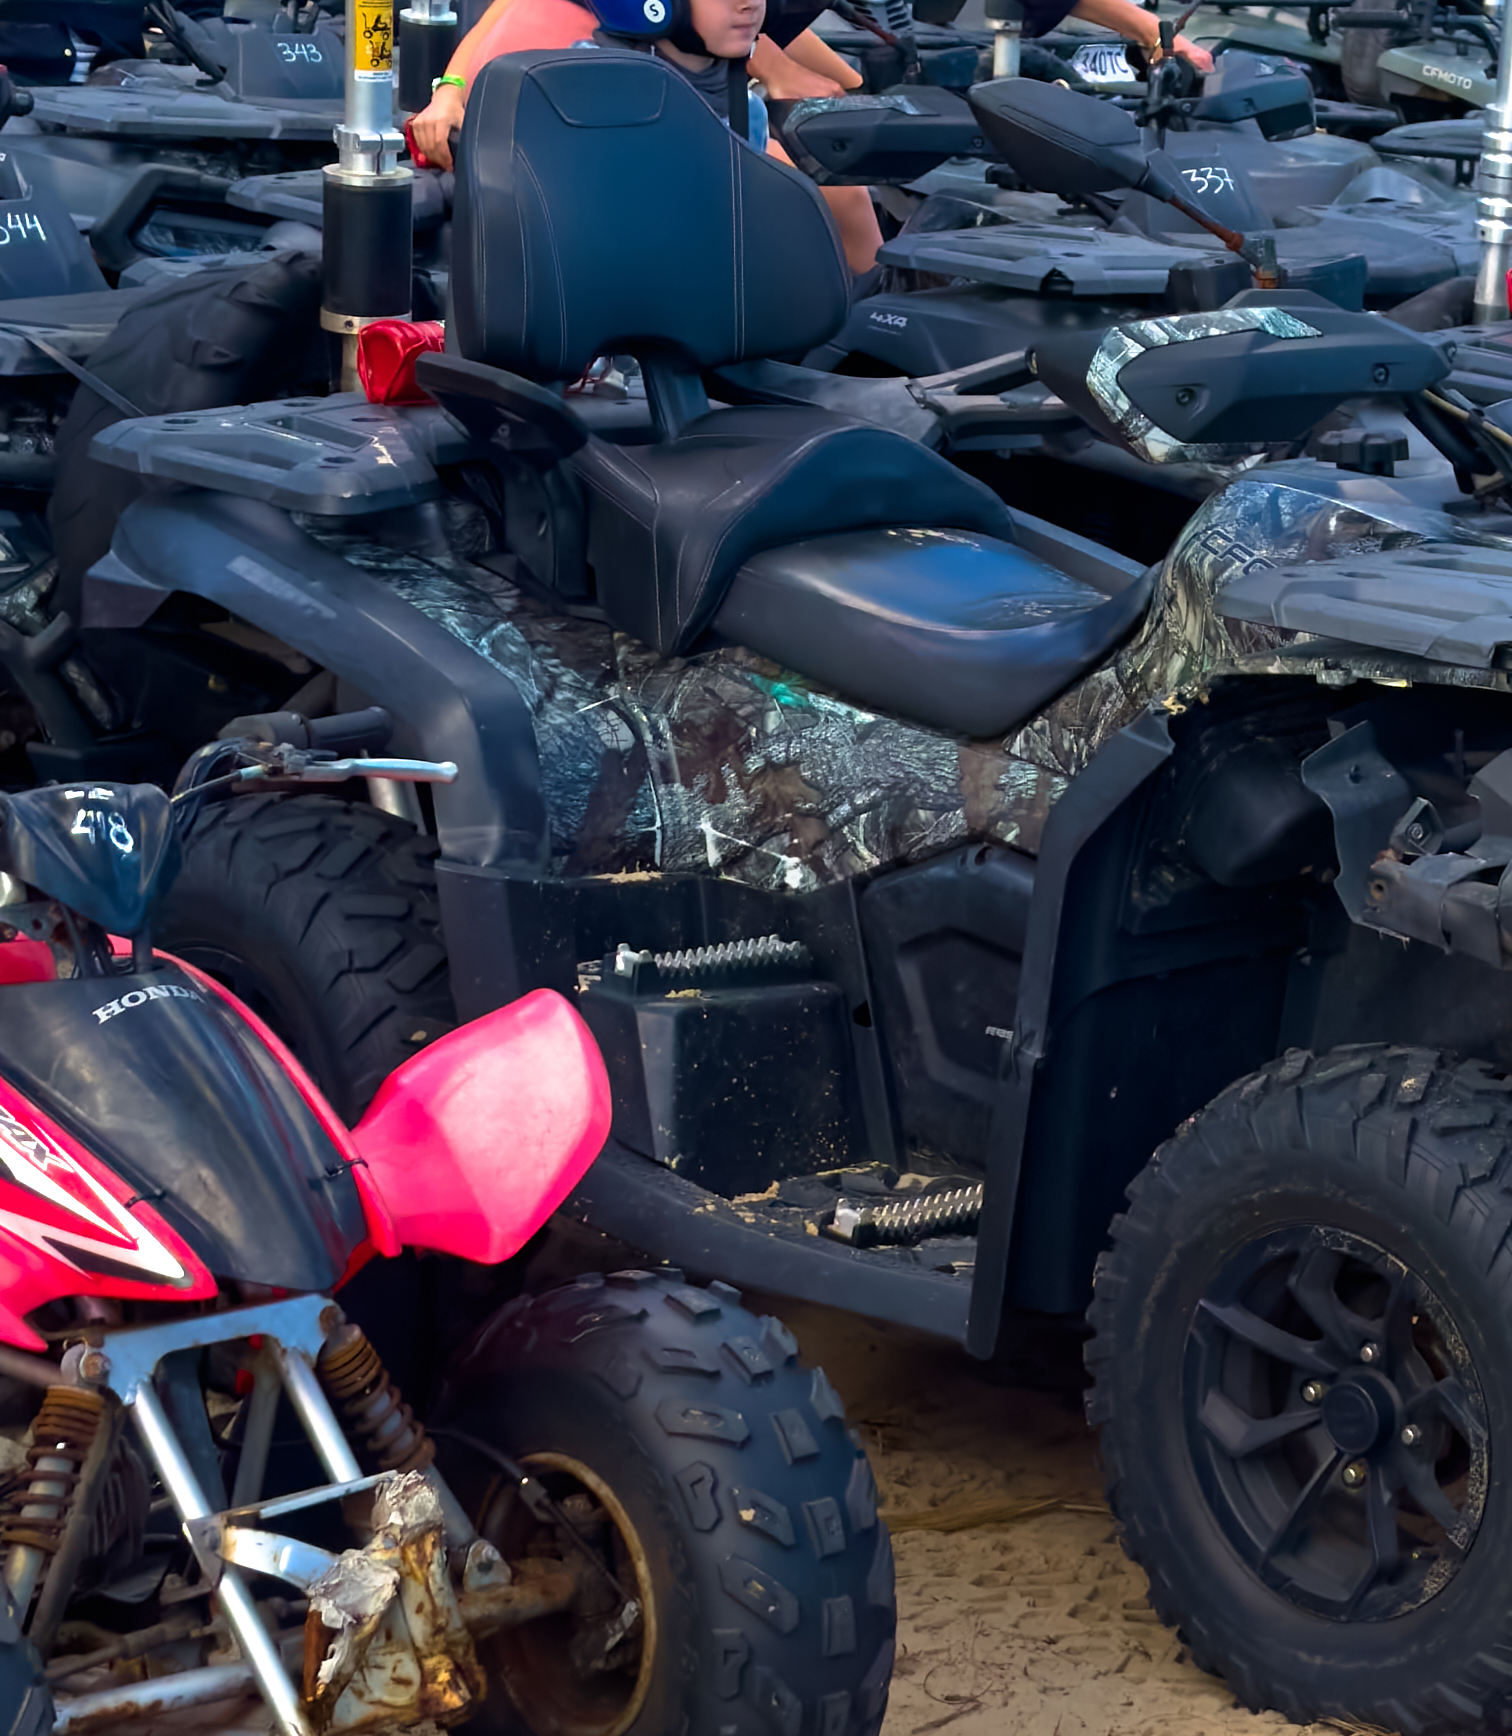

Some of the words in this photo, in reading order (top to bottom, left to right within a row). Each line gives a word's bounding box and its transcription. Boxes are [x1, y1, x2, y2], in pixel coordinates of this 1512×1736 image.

[649, 3, 660, 17] S
[277, 42, 323, 63] 343
[1422, 65, 1473, 89] CFMOTO
[1181, 166, 1235, 194] 337
[70, 807, 136, 854] 418
[91, 984, 216, 1026] HONDA
